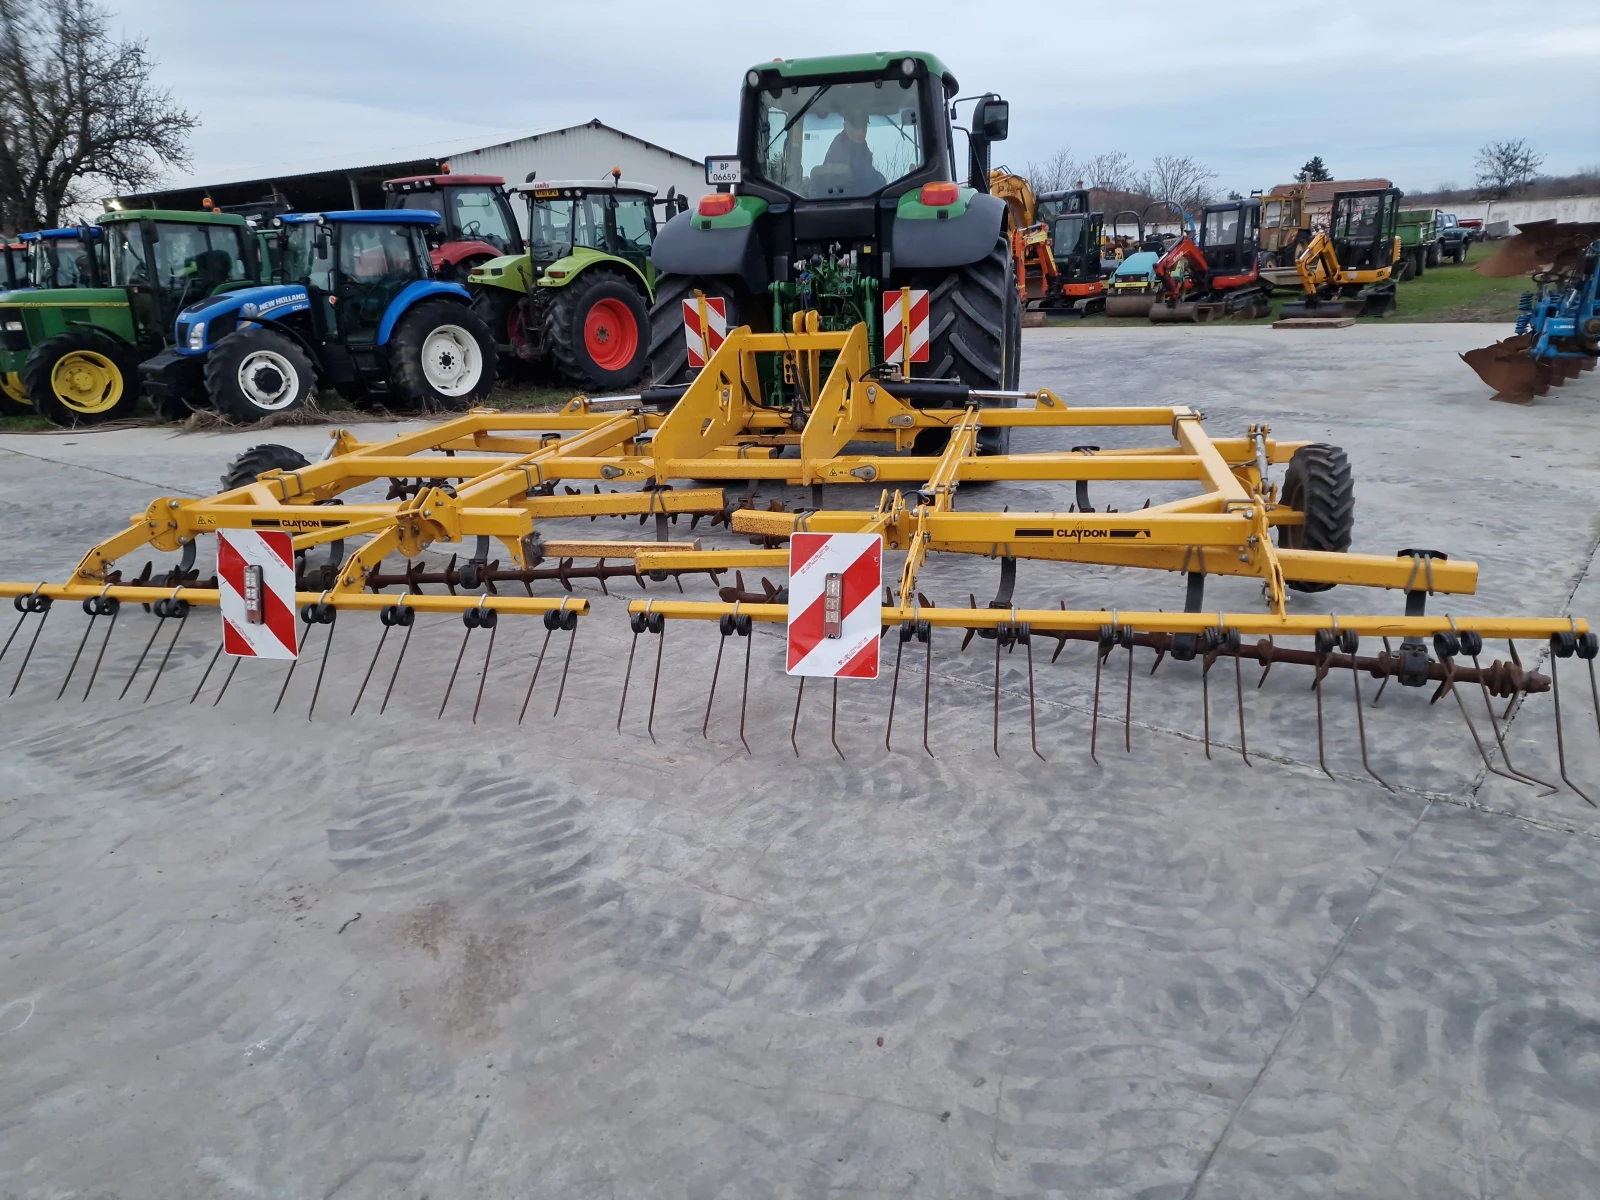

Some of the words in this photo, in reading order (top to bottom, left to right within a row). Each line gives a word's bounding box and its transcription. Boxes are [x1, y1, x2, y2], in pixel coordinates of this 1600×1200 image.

[720, 162, 729, 171] BP
[713, 173, 737, 181] 06659
[259, 299, 275, 311] NEW
[275, 293, 306, 307] HOLLAND
[281, 519, 320, 531] CLAYDON
[1056, 529, 1108, 544] CLAYDON
